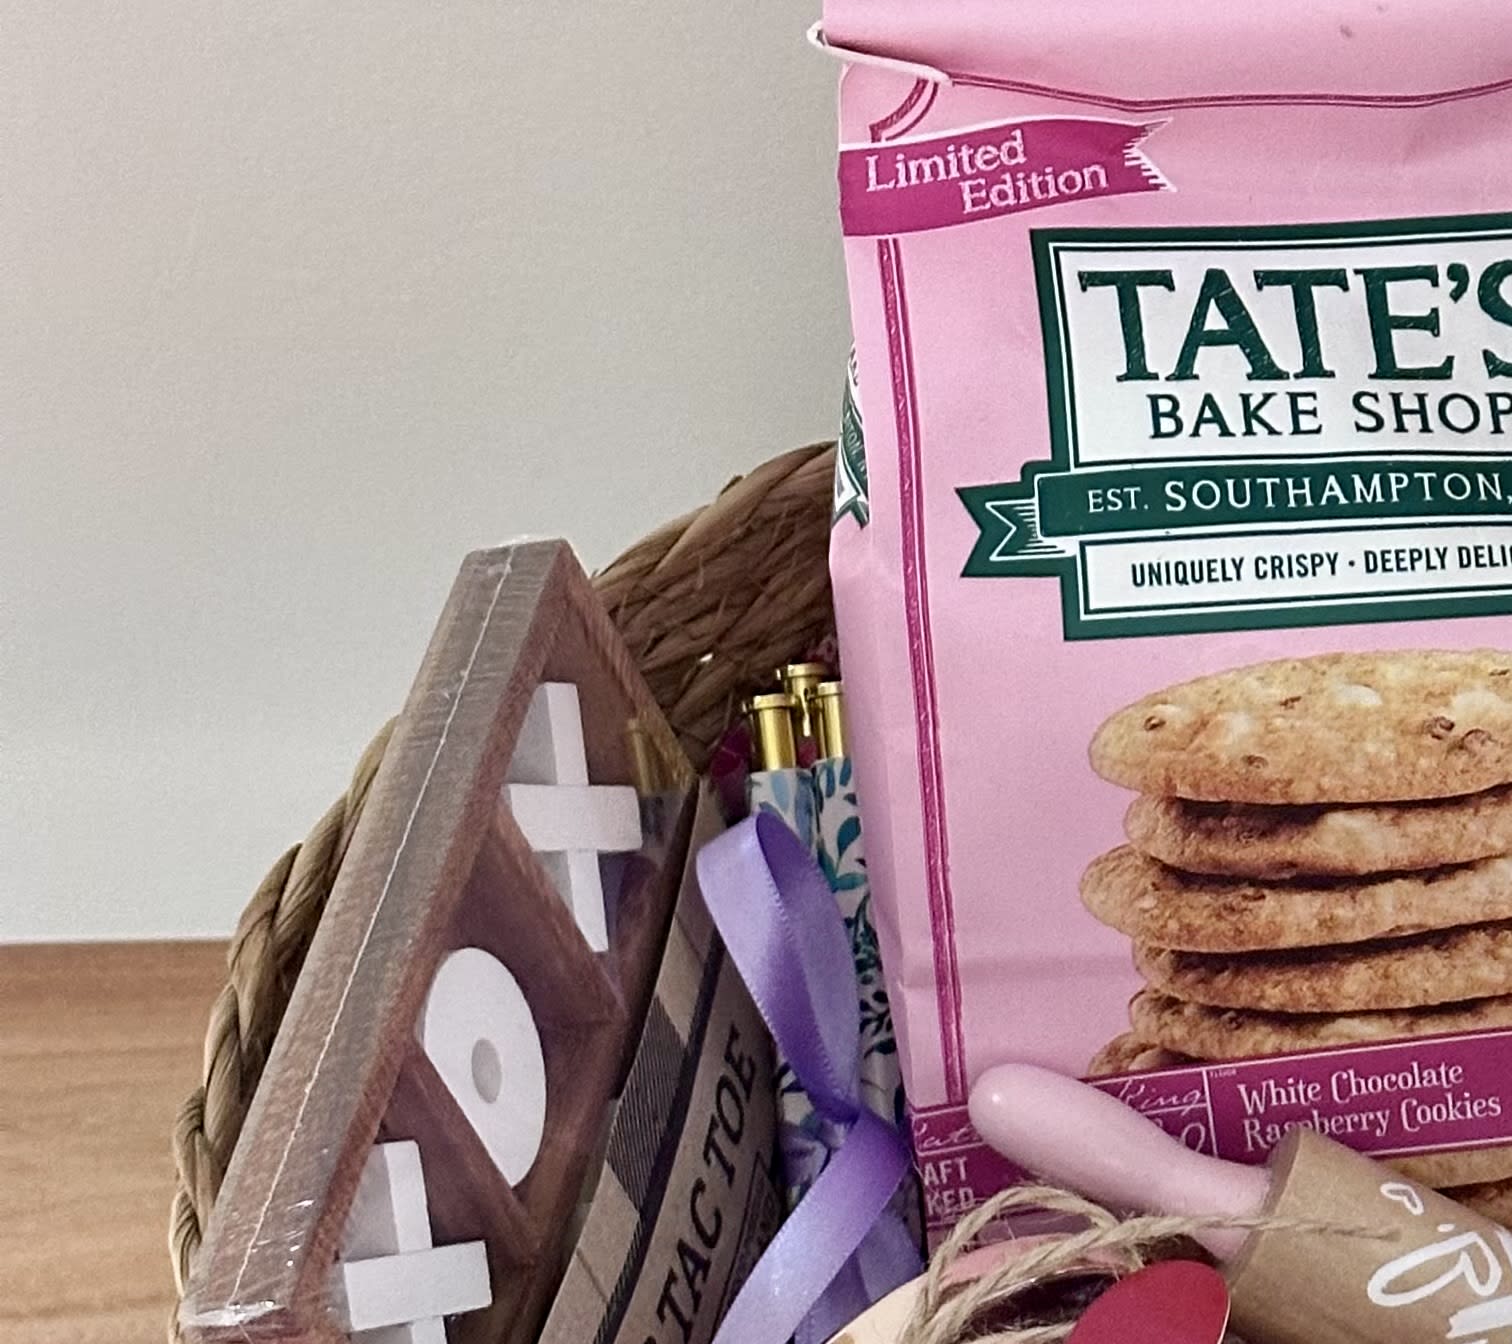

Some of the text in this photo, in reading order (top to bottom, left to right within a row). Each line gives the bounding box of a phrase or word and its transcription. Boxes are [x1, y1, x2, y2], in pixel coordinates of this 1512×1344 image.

[865, 129, 1027, 192] Limited
[959, 164, 1108, 214] Edition
[1148, 392, 1322, 439] BAKE
[1088, 487, 1149, 513] EST.
[1131, 558, 1244, 588] UNIQUELY
[1254, 552, 1339, 579] CRISPY
[1364, 546, 1449, 574] DEEPLY
[1237, 1061, 1464, 1115] White Chocolate
[1400, 1092, 1502, 1133] Cookies
[657, 1177, 722, 1344] TAC
[704, 1023, 756, 1189] TOE
